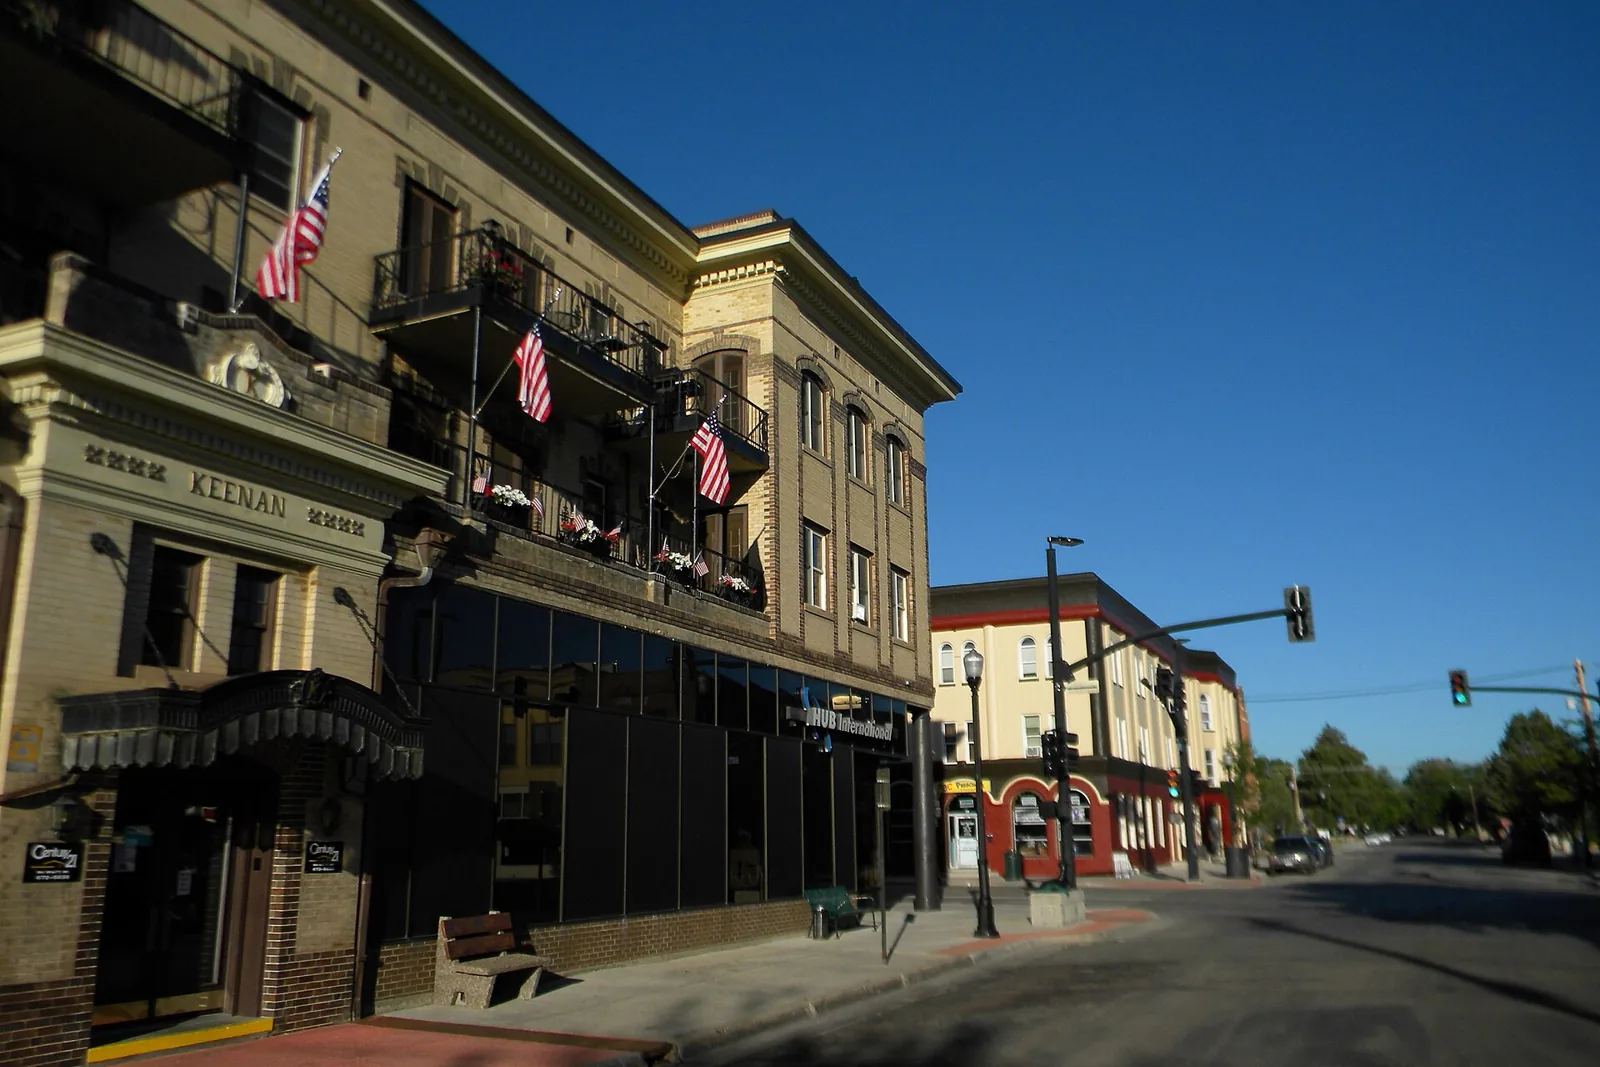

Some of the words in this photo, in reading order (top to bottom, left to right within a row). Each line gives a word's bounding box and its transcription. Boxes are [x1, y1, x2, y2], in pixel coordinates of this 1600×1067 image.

[189, 470, 286, 518] KEENAN
[812, 707, 836, 730] HUB
[836, 712, 893, 741] International
[31, 844, 72, 860] Century
[65, 854, 78, 868] 21
[310, 843, 335, 855] Century
[330, 850, 339, 862] 21
